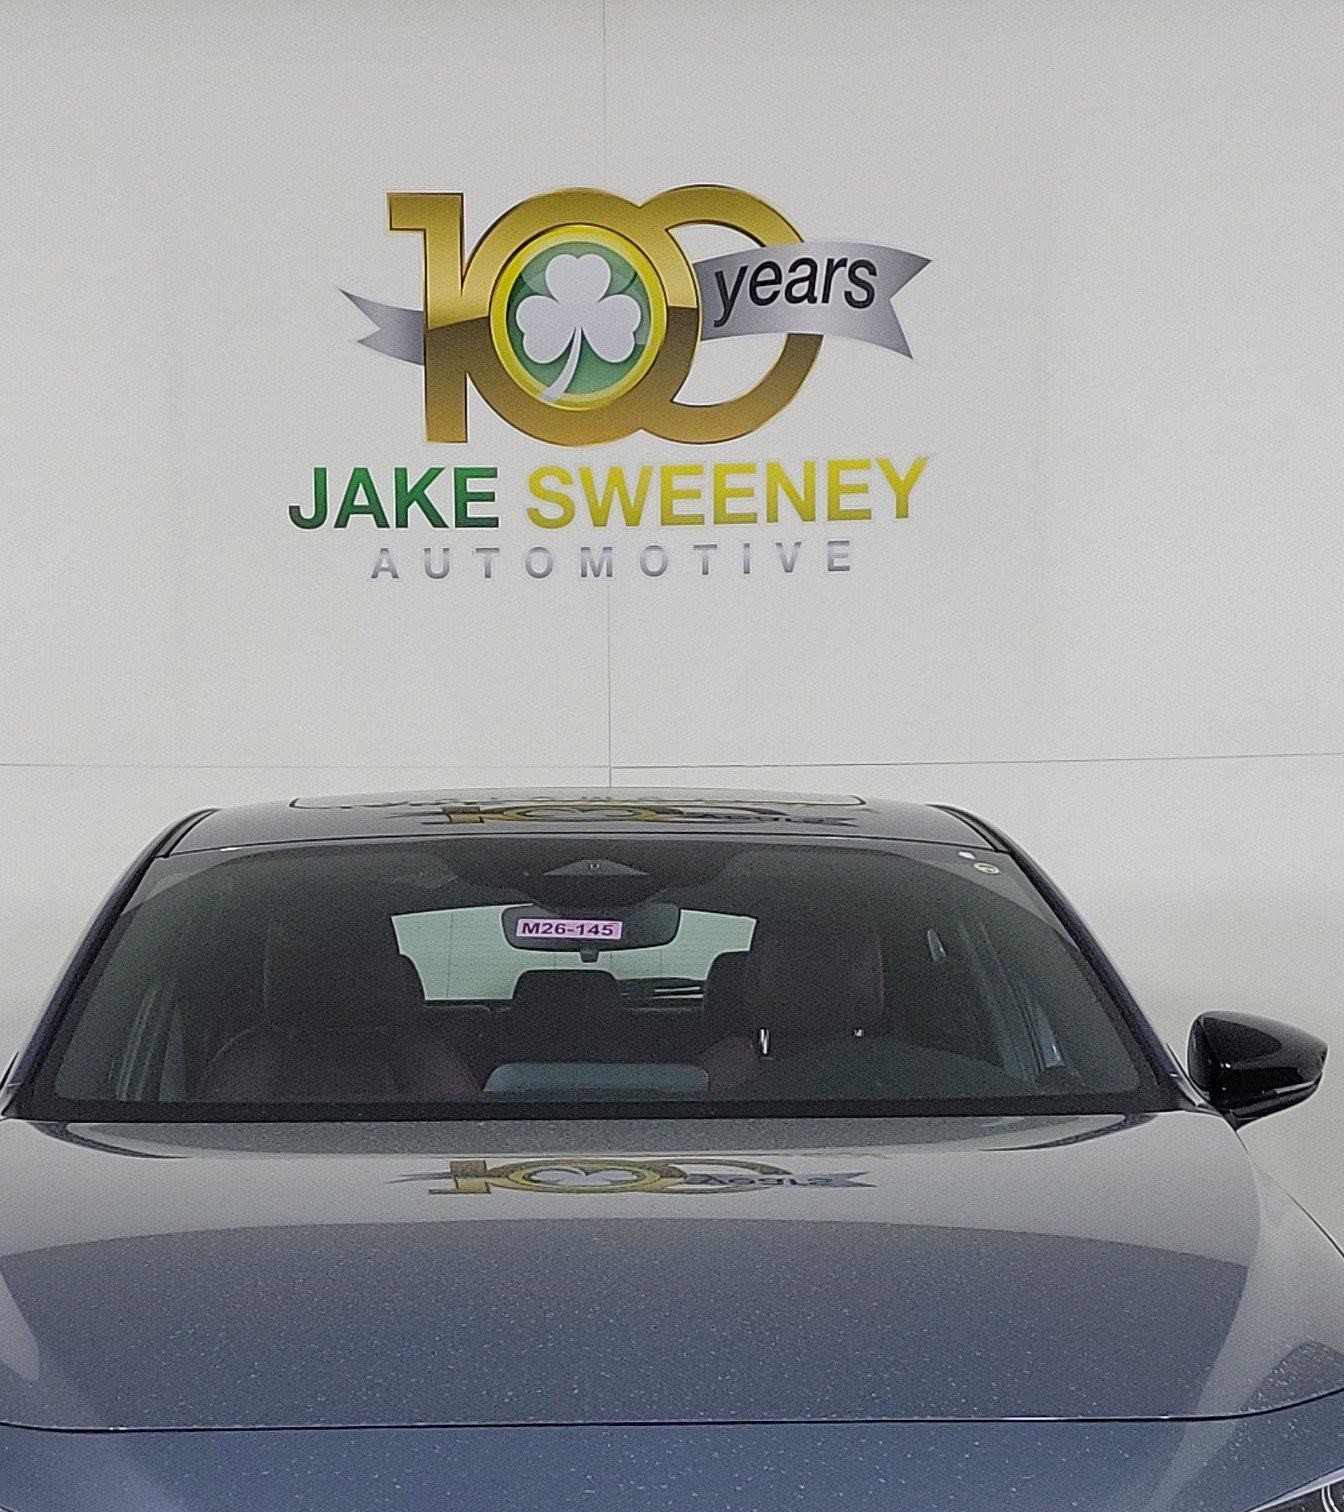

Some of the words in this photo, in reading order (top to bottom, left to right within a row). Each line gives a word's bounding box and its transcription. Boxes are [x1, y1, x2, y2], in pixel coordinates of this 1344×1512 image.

[386, 184, 824, 446] 100
[713, 256, 878, 329] years
[289, 466, 499, 530] JAKE
[527, 456, 931, 530] SWEENEY
[370, 540, 852, 580] AUTOMOTIVE
[522, 922, 614, 936] M26-145
